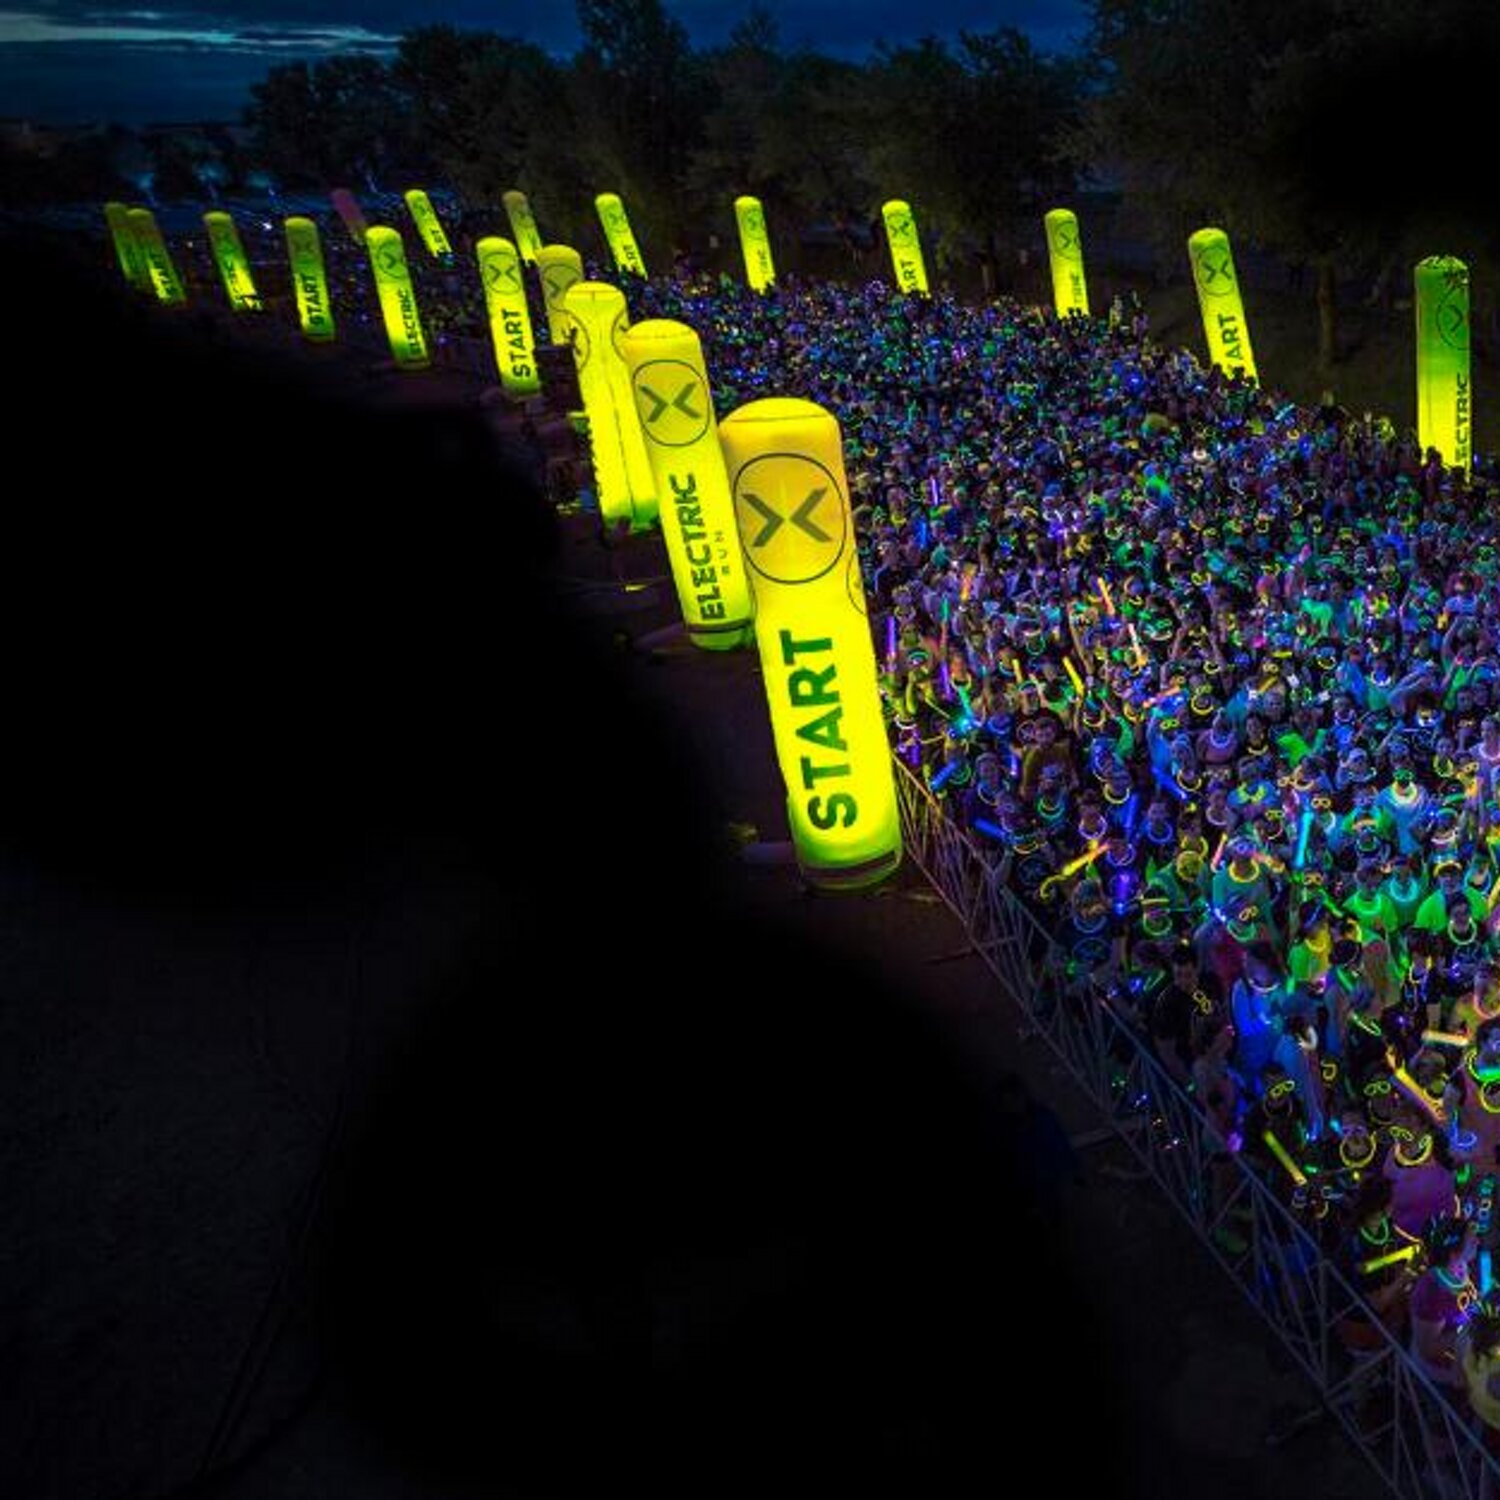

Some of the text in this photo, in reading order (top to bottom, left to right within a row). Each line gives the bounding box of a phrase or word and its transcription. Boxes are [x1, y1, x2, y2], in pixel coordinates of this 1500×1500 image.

[501, 308, 531, 377] START
[1217, 313, 1245, 362] ART
[1455, 372, 1469, 463] ECTRIC
[669, 473, 726, 620] ELECTRIC
[780, 628, 858, 830] START
